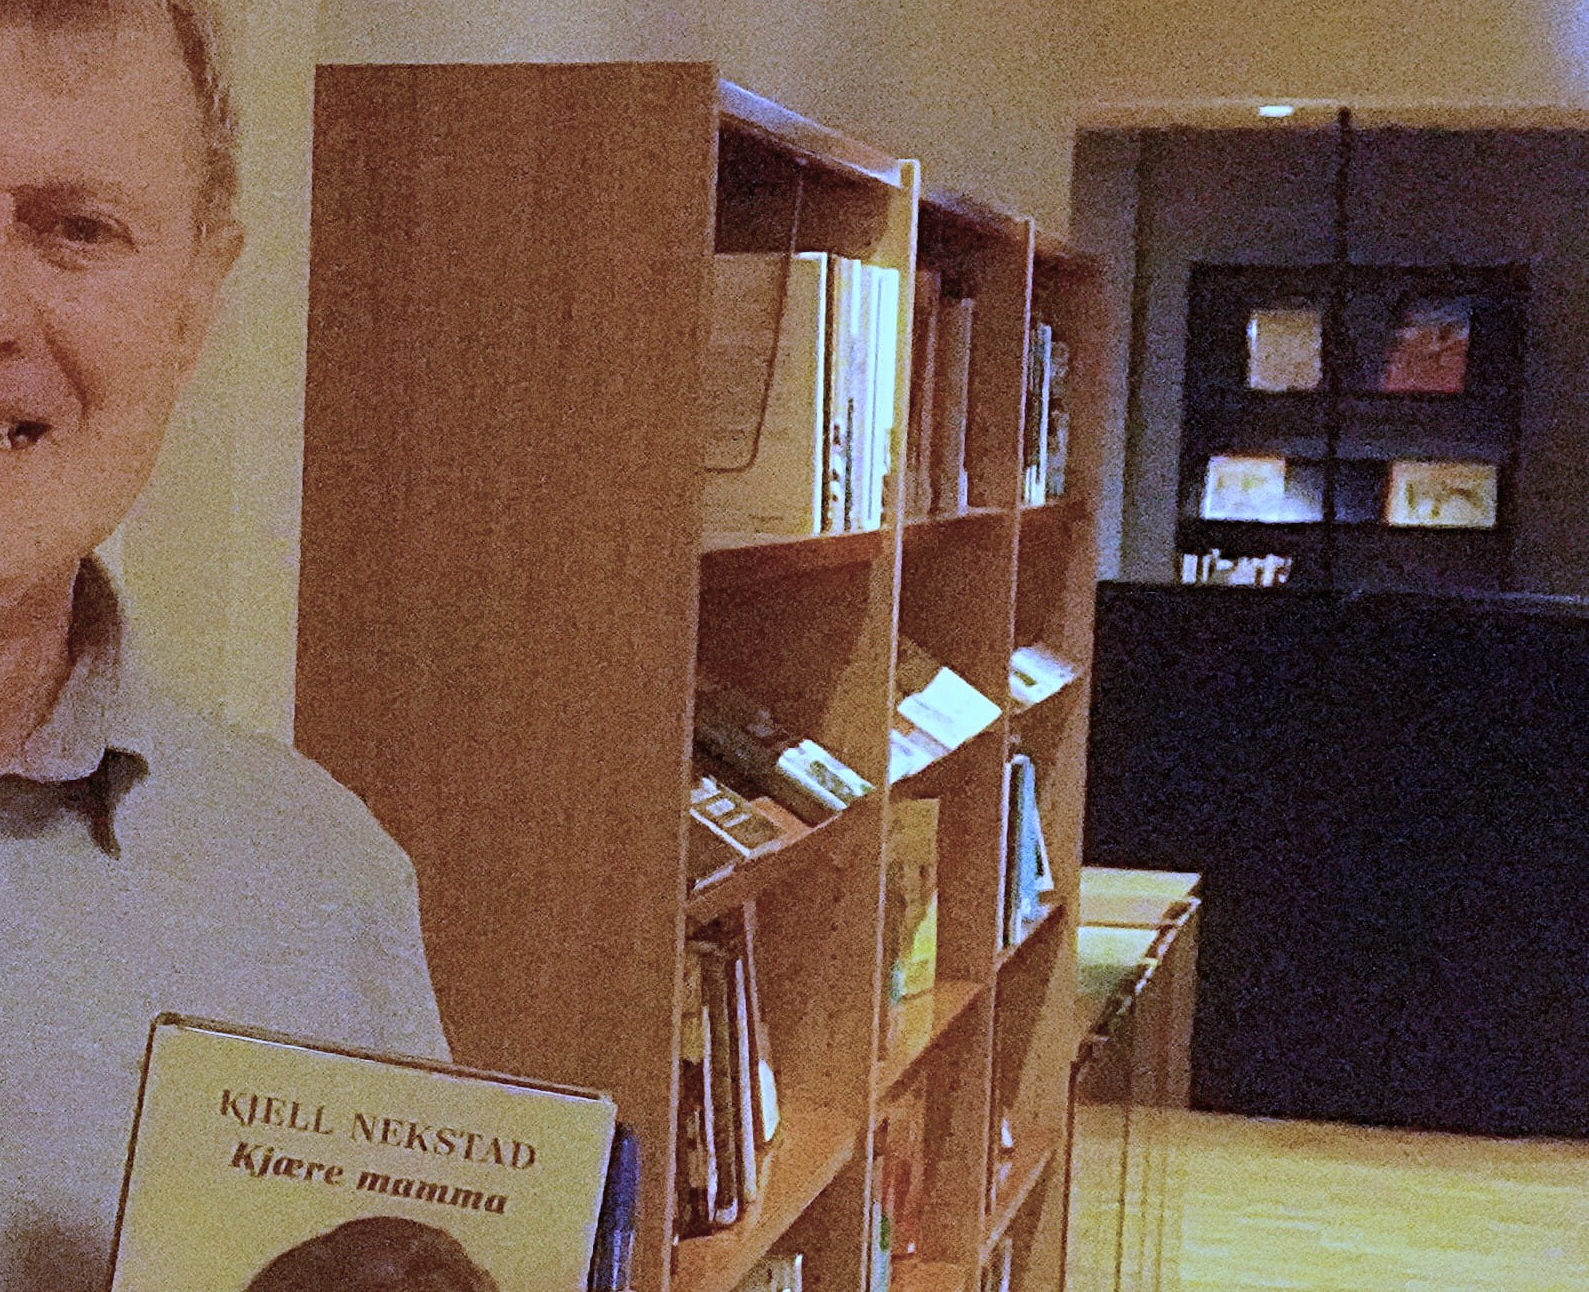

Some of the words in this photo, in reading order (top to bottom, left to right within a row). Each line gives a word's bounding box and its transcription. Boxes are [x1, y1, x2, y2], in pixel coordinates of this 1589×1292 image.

[218, 1088, 334, 1136] KJELL
[348, 1111, 538, 1170] NEKSTAD
[227, 1140, 345, 1187] Kjære
[356, 1170, 509, 1215] mamma
